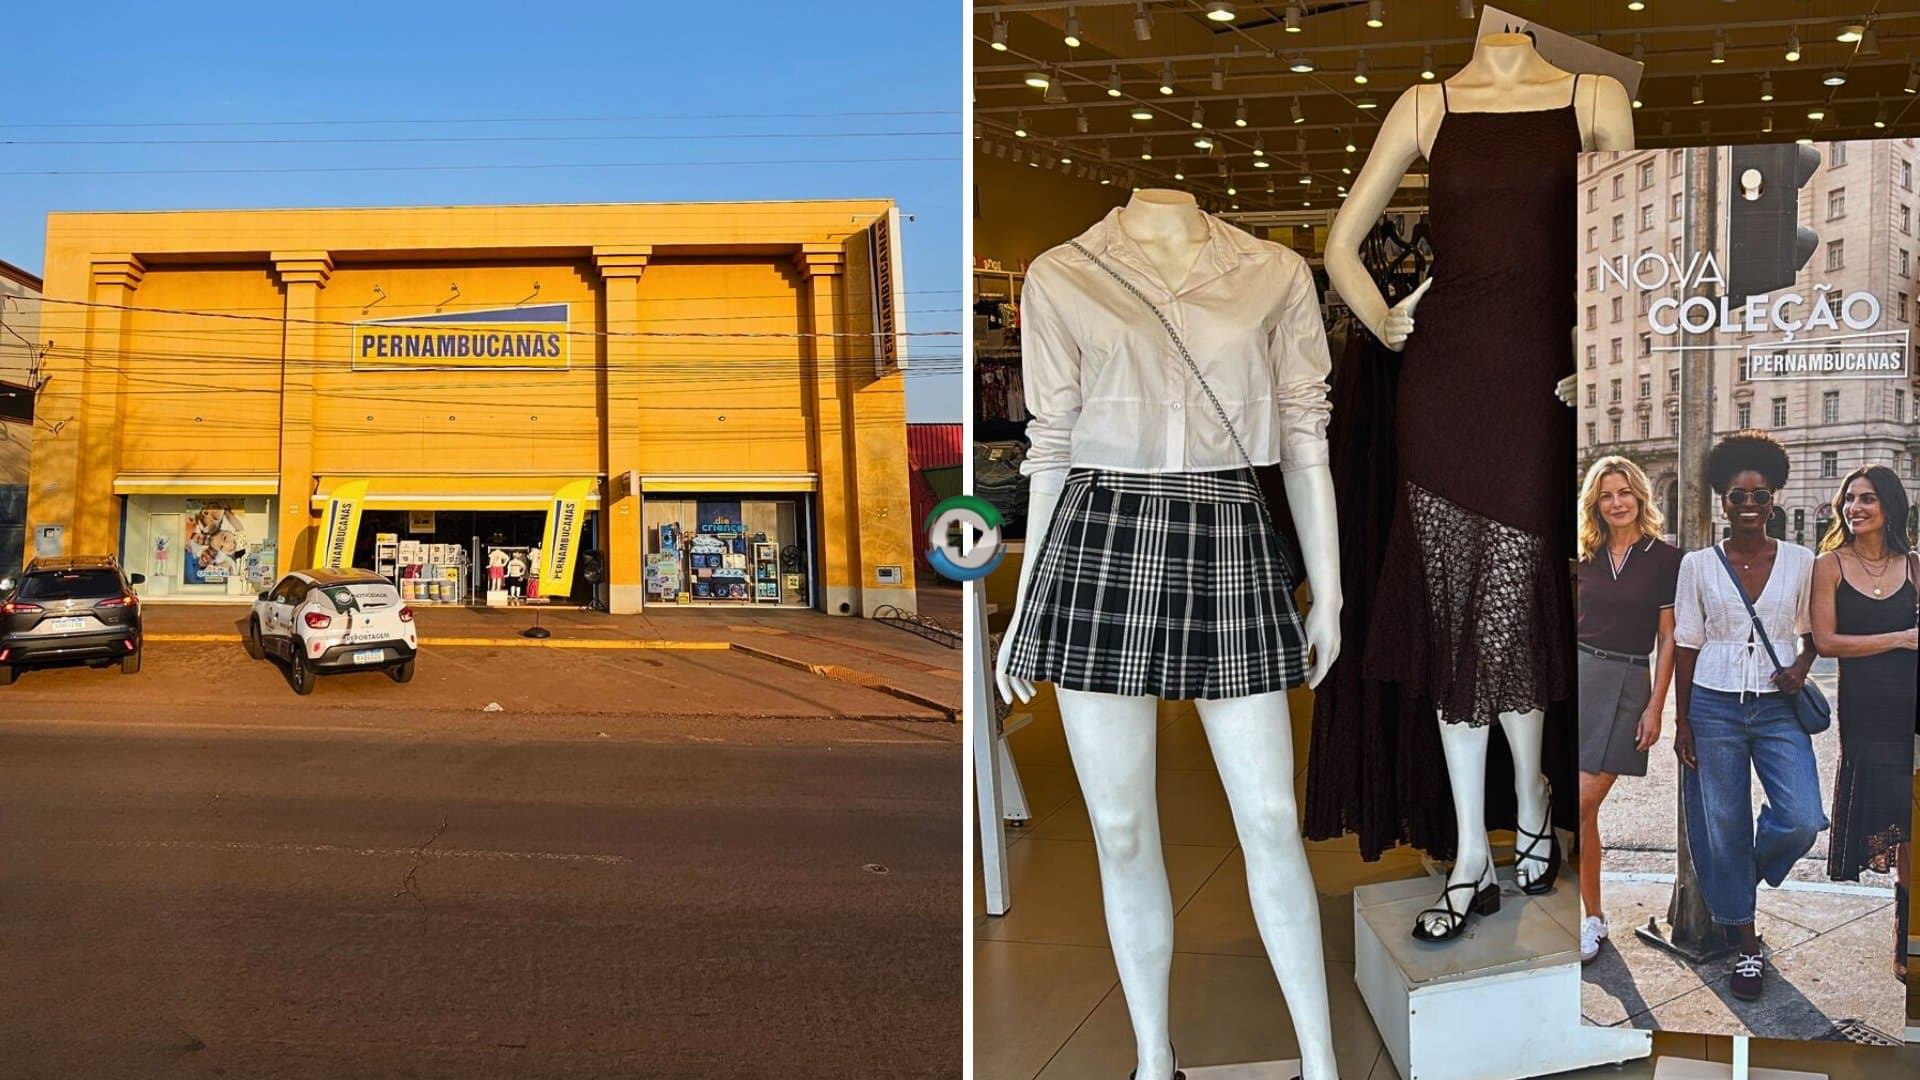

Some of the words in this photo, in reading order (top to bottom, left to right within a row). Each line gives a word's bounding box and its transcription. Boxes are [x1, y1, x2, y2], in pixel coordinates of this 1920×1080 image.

[877, 219, 894, 366] PERNAMBUCANAS
[1600, 251, 1725, 292] NOVA
[1648, 283, 1880, 342] COLEÇÃO
[362, 334, 560, 358] PERNAMBUCANAS
[1753, 352, 1900, 372] PERNAMBUCANAS
[331, 503, 352, 568] RNAMBUCANAS
[554, 503, 575, 579] PERNAMBUCANAS
